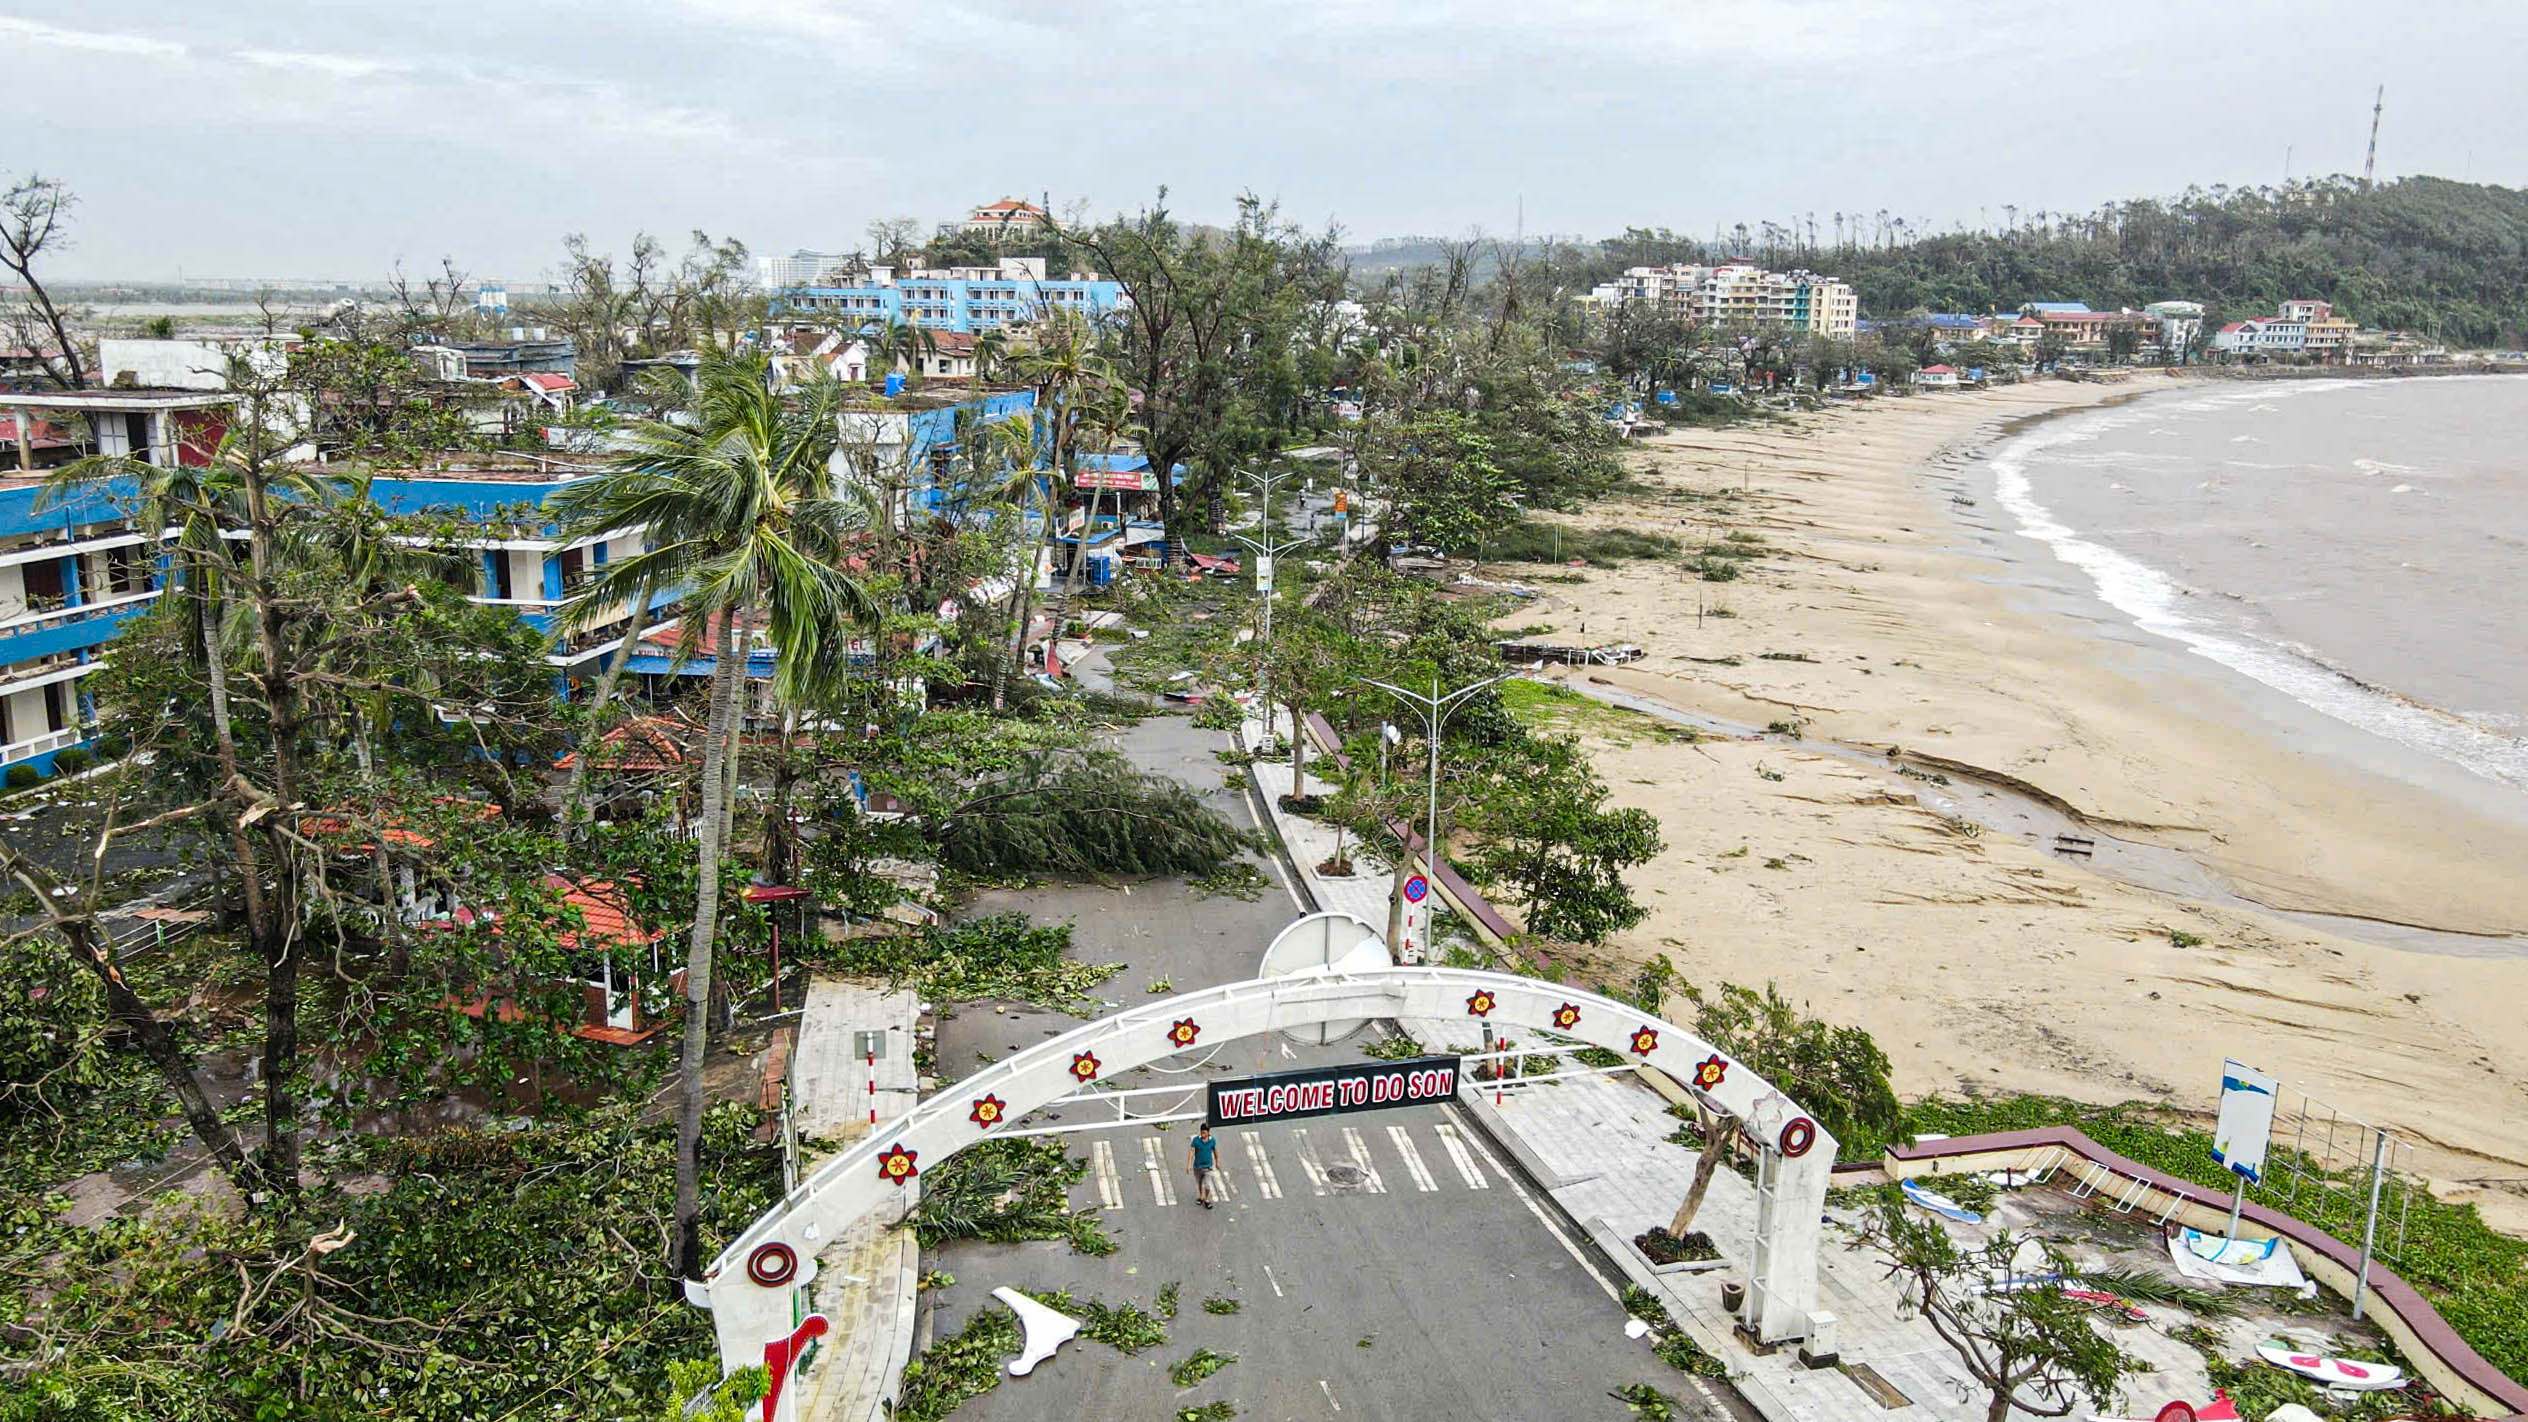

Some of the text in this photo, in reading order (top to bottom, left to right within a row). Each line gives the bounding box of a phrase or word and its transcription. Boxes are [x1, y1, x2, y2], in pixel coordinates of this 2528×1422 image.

[1218, 1068, 1453, 1119] WELCOME TO DO SON
